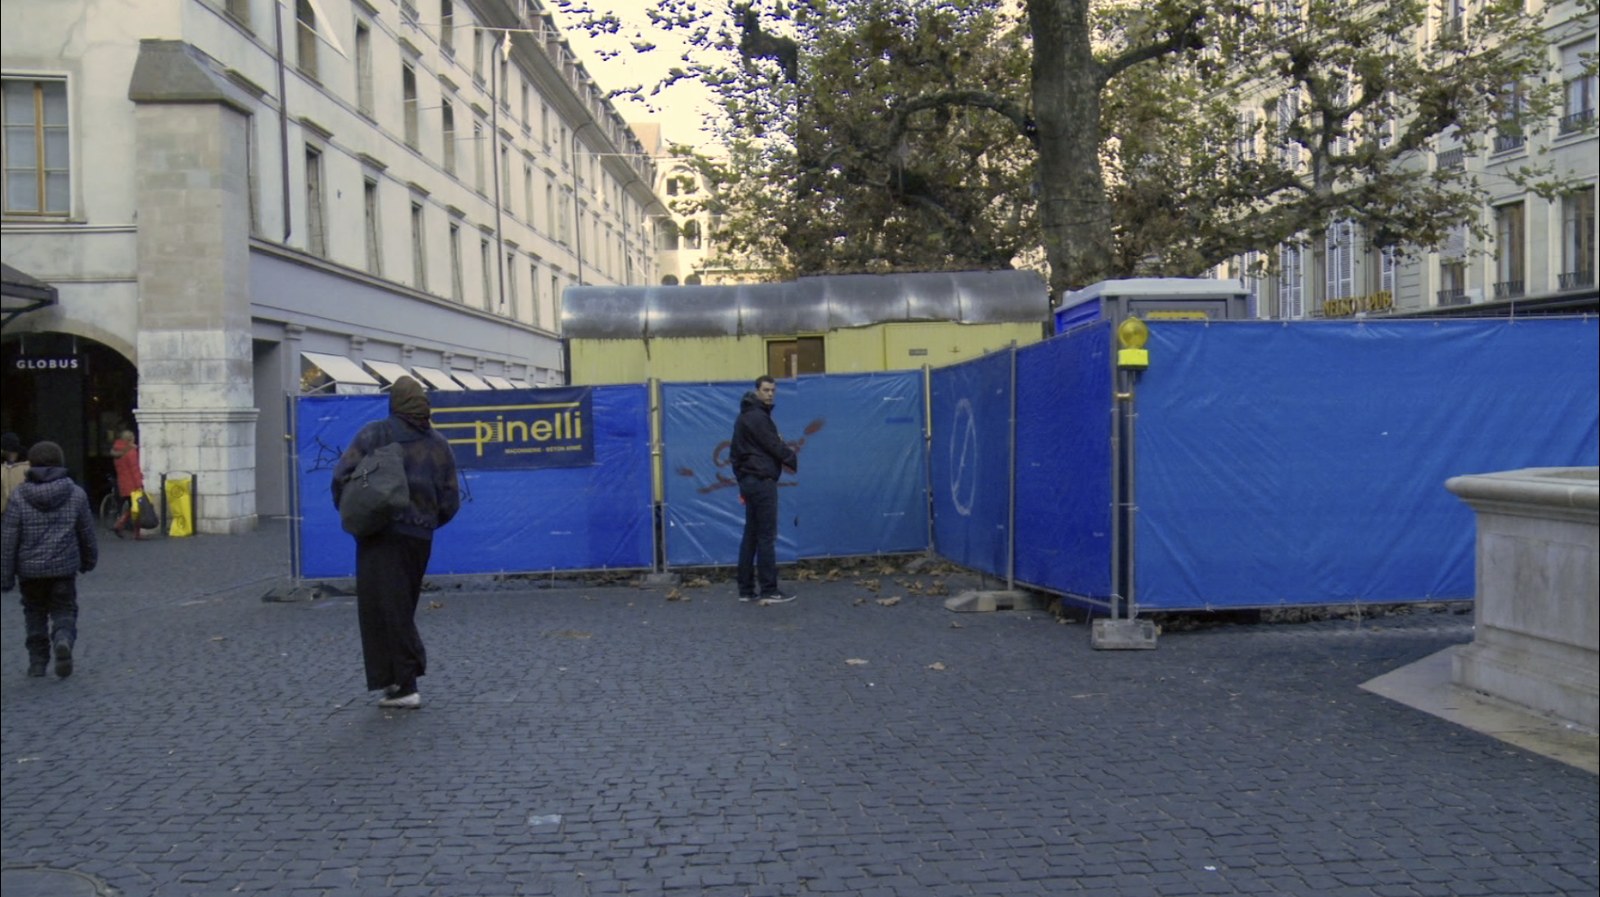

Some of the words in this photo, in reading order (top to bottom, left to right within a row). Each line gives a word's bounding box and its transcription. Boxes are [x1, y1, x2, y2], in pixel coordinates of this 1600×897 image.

[1368, 290, 1392, 310] PUB
[16, 359, 79, 369] GLOBUS
[475, 411, 582, 457] pinelli
